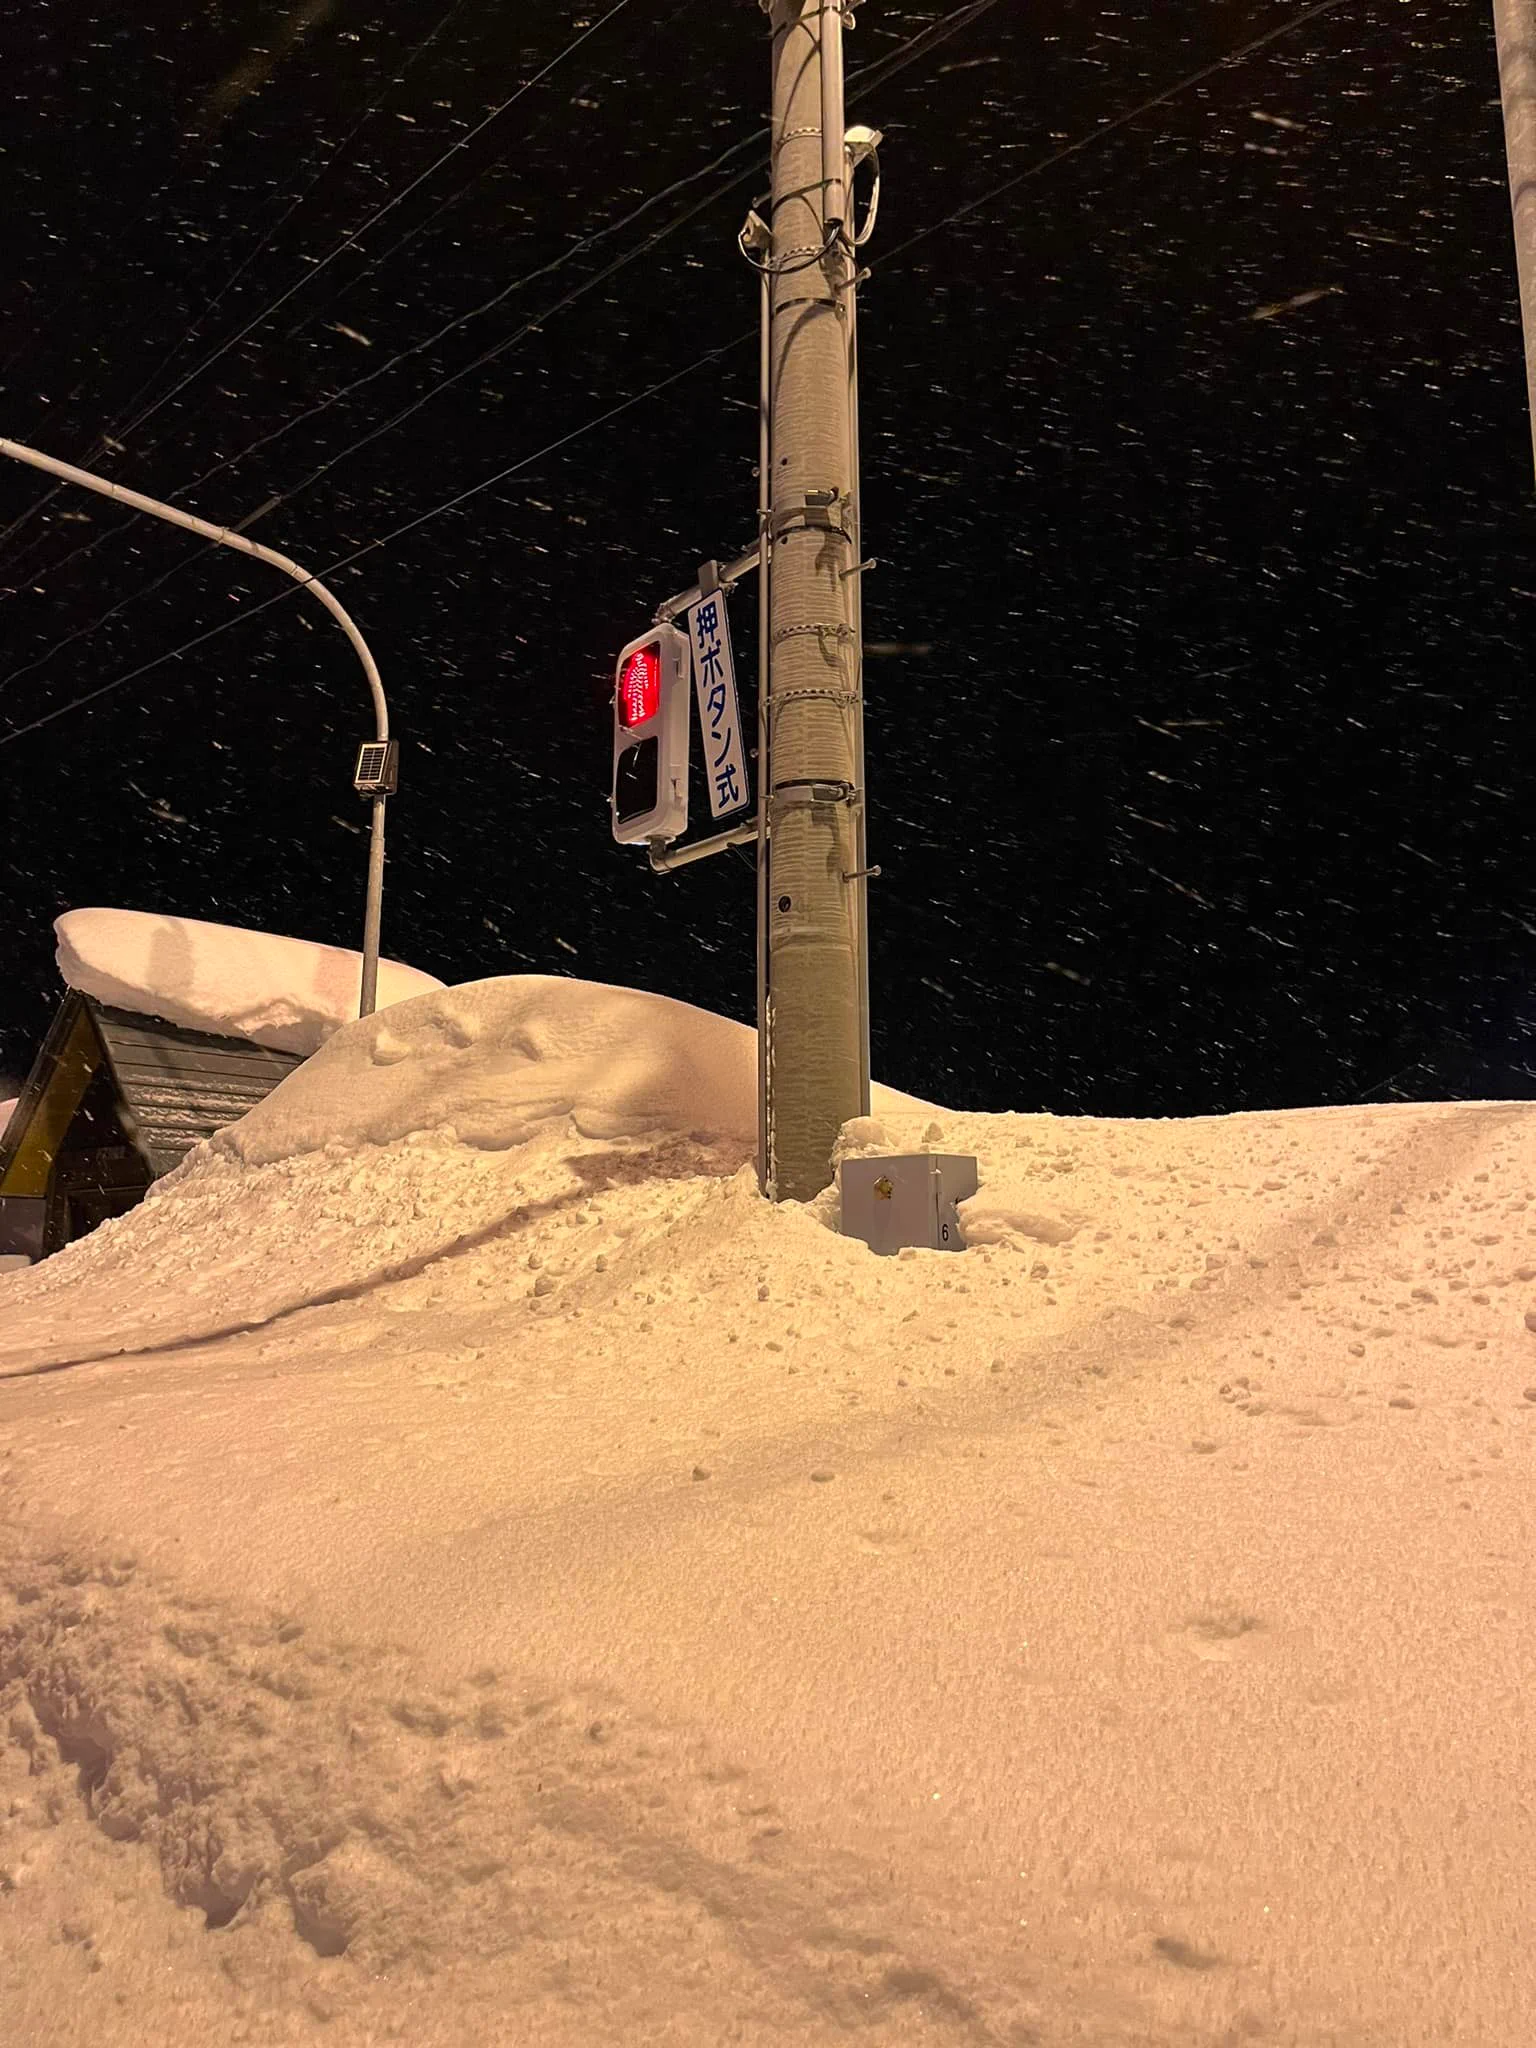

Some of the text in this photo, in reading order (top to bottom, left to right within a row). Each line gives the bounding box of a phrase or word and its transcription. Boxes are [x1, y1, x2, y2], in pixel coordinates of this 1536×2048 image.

[696, 601, 739, 809] 押ボタン式
[942, 1223, 949, 1242] 6
